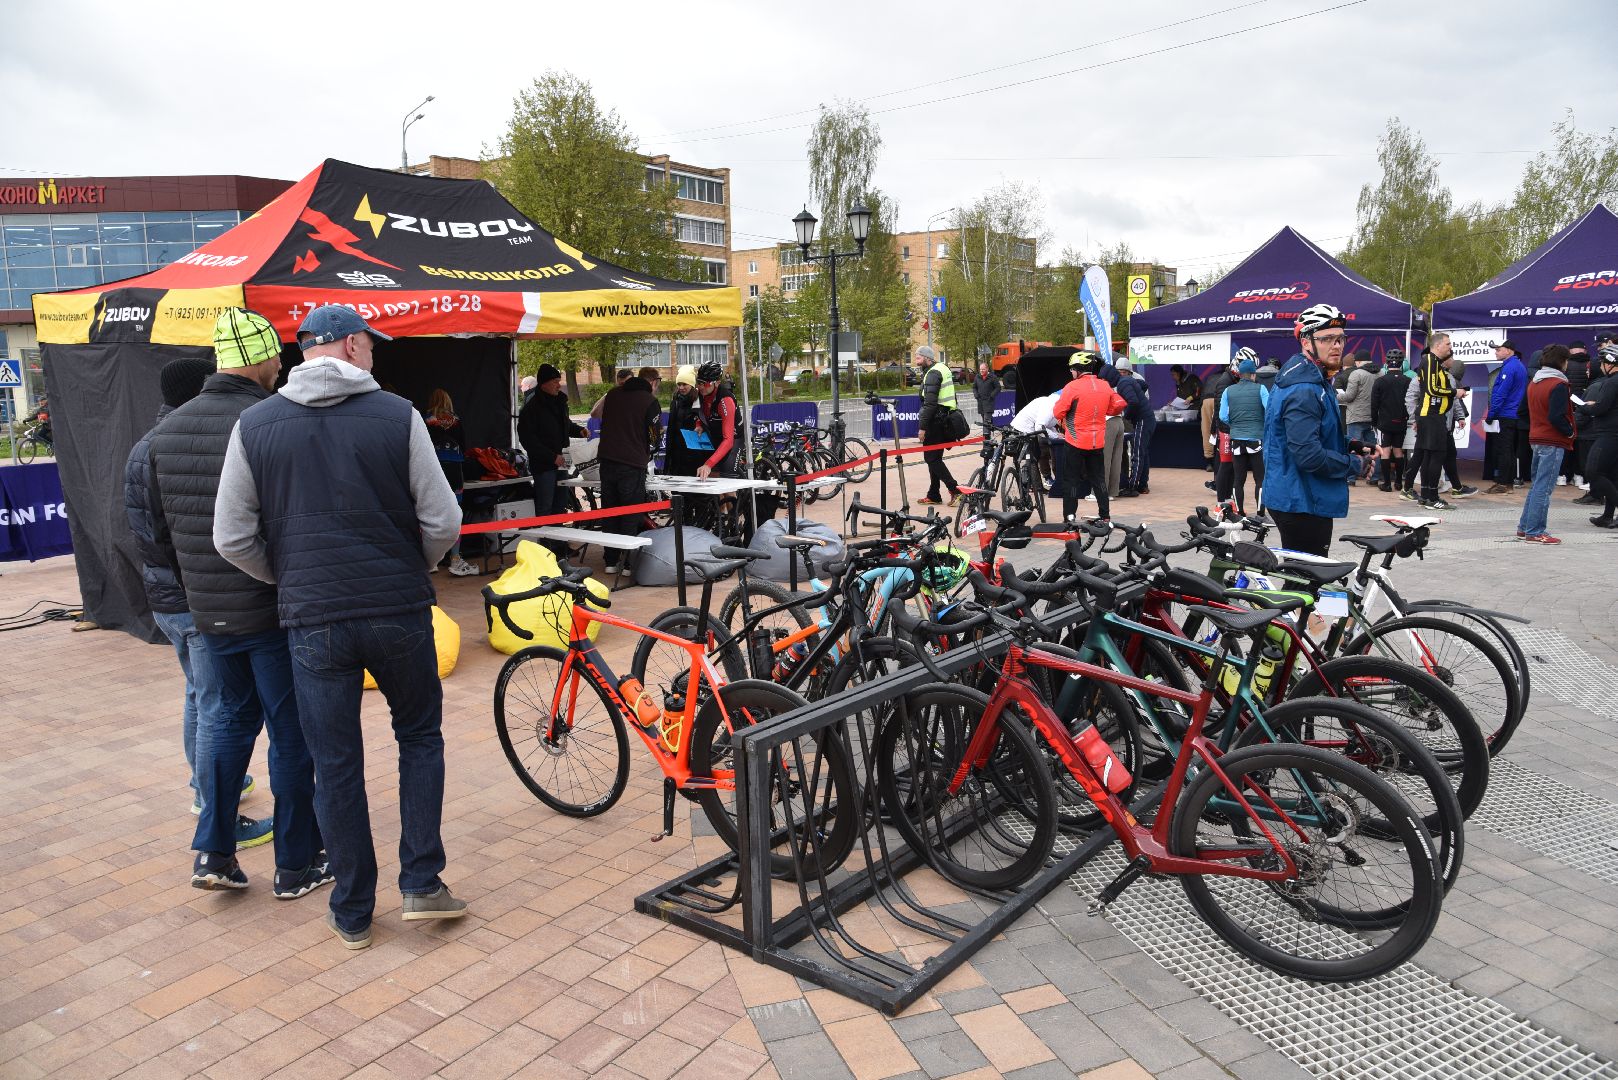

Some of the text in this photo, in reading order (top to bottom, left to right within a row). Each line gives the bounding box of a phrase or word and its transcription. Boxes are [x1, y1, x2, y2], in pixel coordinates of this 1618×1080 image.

[507, 236, 533, 246] TEAM
[1557, 270, 1618, 284] GRA
[1133, 282, 1144, 290] 40
[1234, 286, 1297, 298] GRAN
[1227, 292, 1310, 304] FONDO
[105, 306, 150, 322] ZUBOV
[582, 301, 711, 318] www.zubovteam.ru
[1490, 303, 1618, 318] ТВОЙ БОЛЬШОЙ
[1208, 311, 1274, 324] БОЛЬШОЙ
[1147, 342, 1212, 352] РЕГИСТРАЦИЯ
